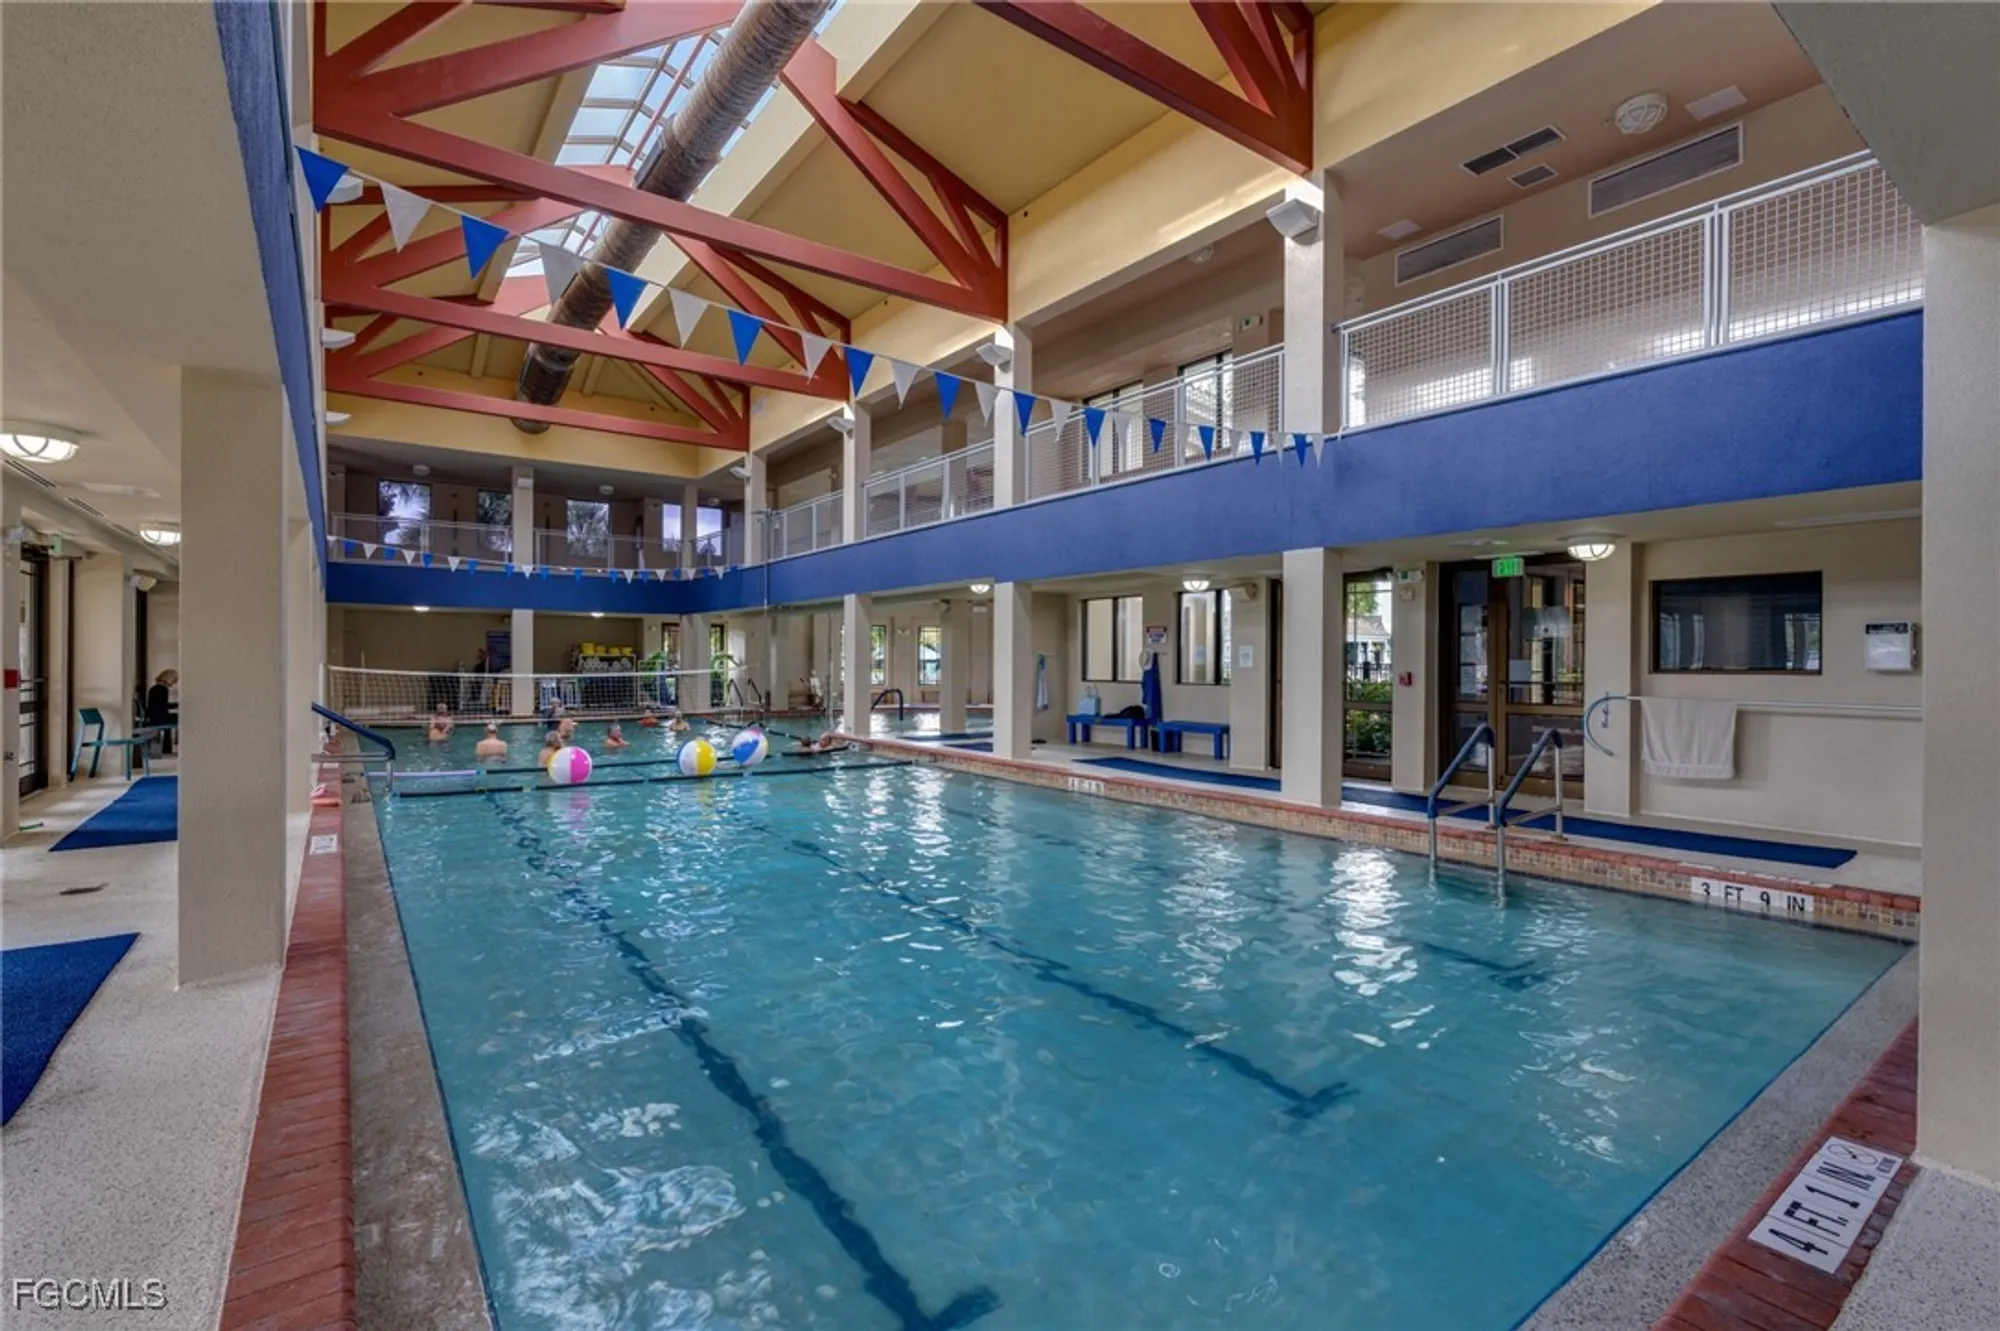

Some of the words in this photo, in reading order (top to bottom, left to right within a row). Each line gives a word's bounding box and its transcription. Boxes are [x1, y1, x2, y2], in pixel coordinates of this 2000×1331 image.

[1701, 882, 1710, 896] 3
[1724, 885, 1744, 901] FT
[1760, 891, 1771, 905] 9
[1787, 896, 1804, 911] IN
[1768, 1228, 1829, 1255] 4
[1805, 1185, 1860, 1209] 1
